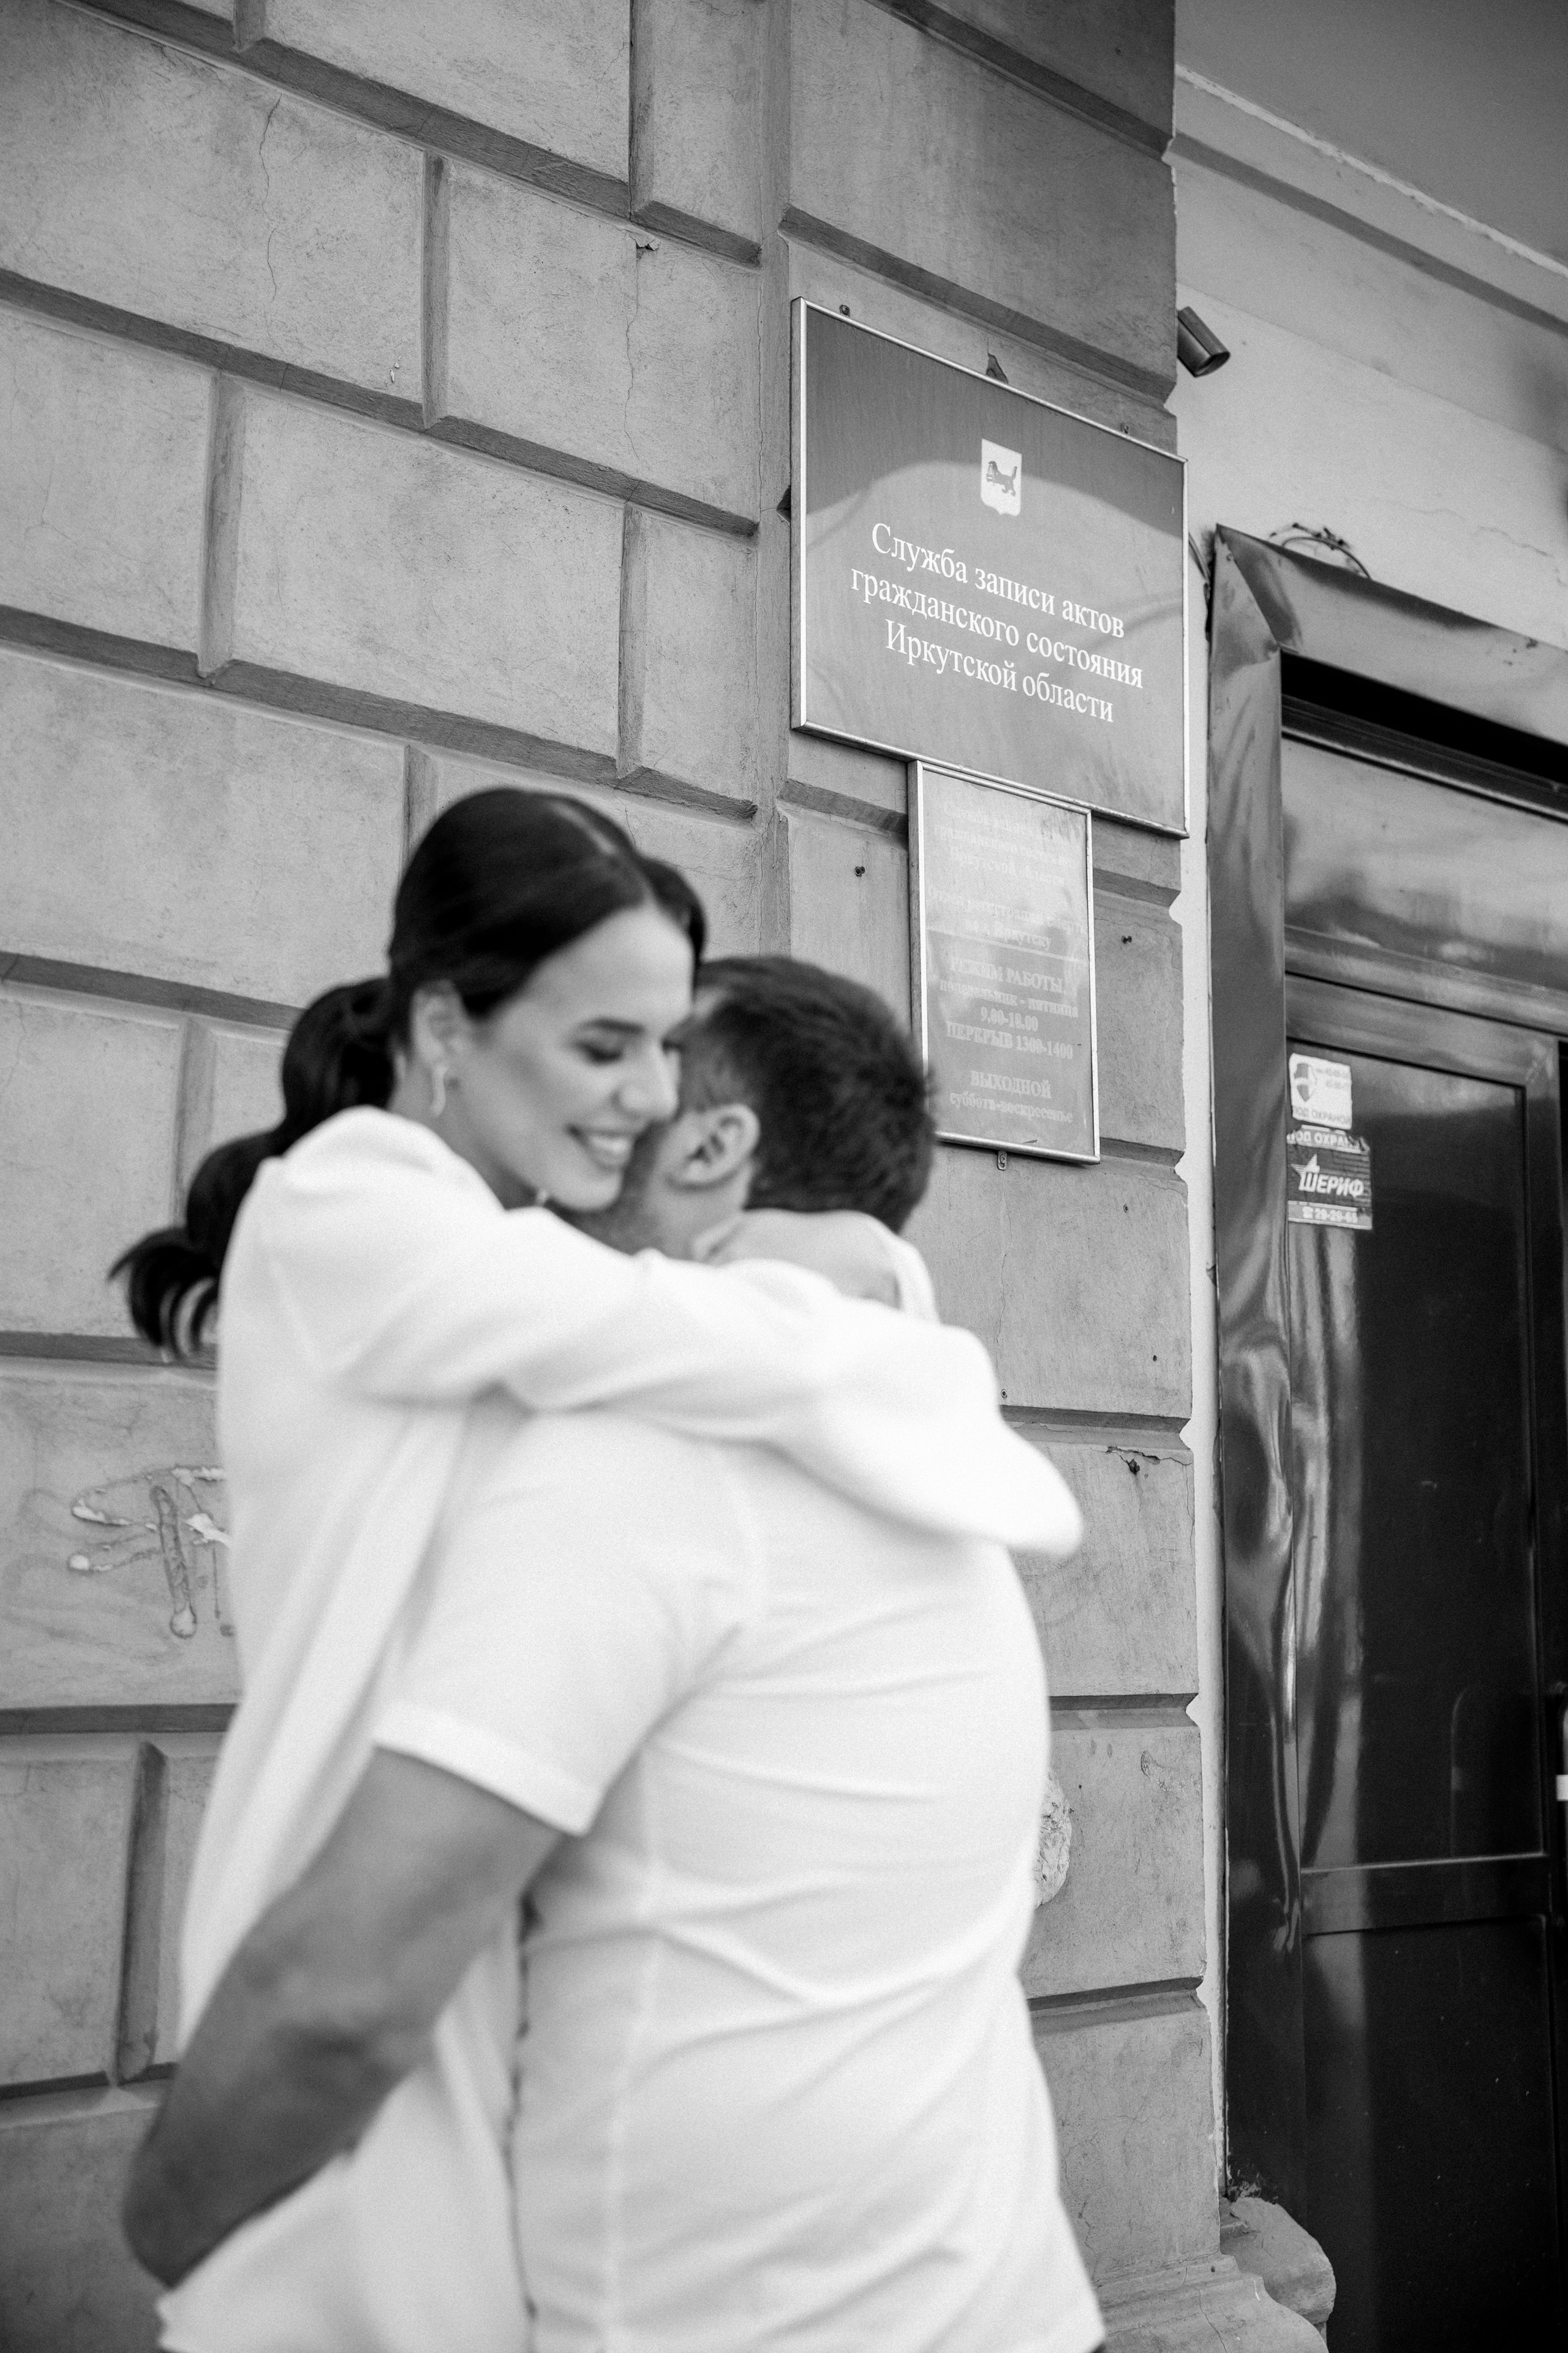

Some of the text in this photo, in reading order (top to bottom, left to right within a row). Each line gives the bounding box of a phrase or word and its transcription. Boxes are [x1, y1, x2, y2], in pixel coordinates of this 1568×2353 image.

[872, 523, 1125, 638] Служба записи актов
[851, 568, 1144, 689] гражданского состояния
[885, 619, 1114, 723] Иркутской области
[946, 1021, 1013, 1049] ПЕРЕРЫВ
[970, 1070, 1052, 1099] ВЫХОДНОЙ
[1298, 1171, 1364, 1198] ШЕРИФ
